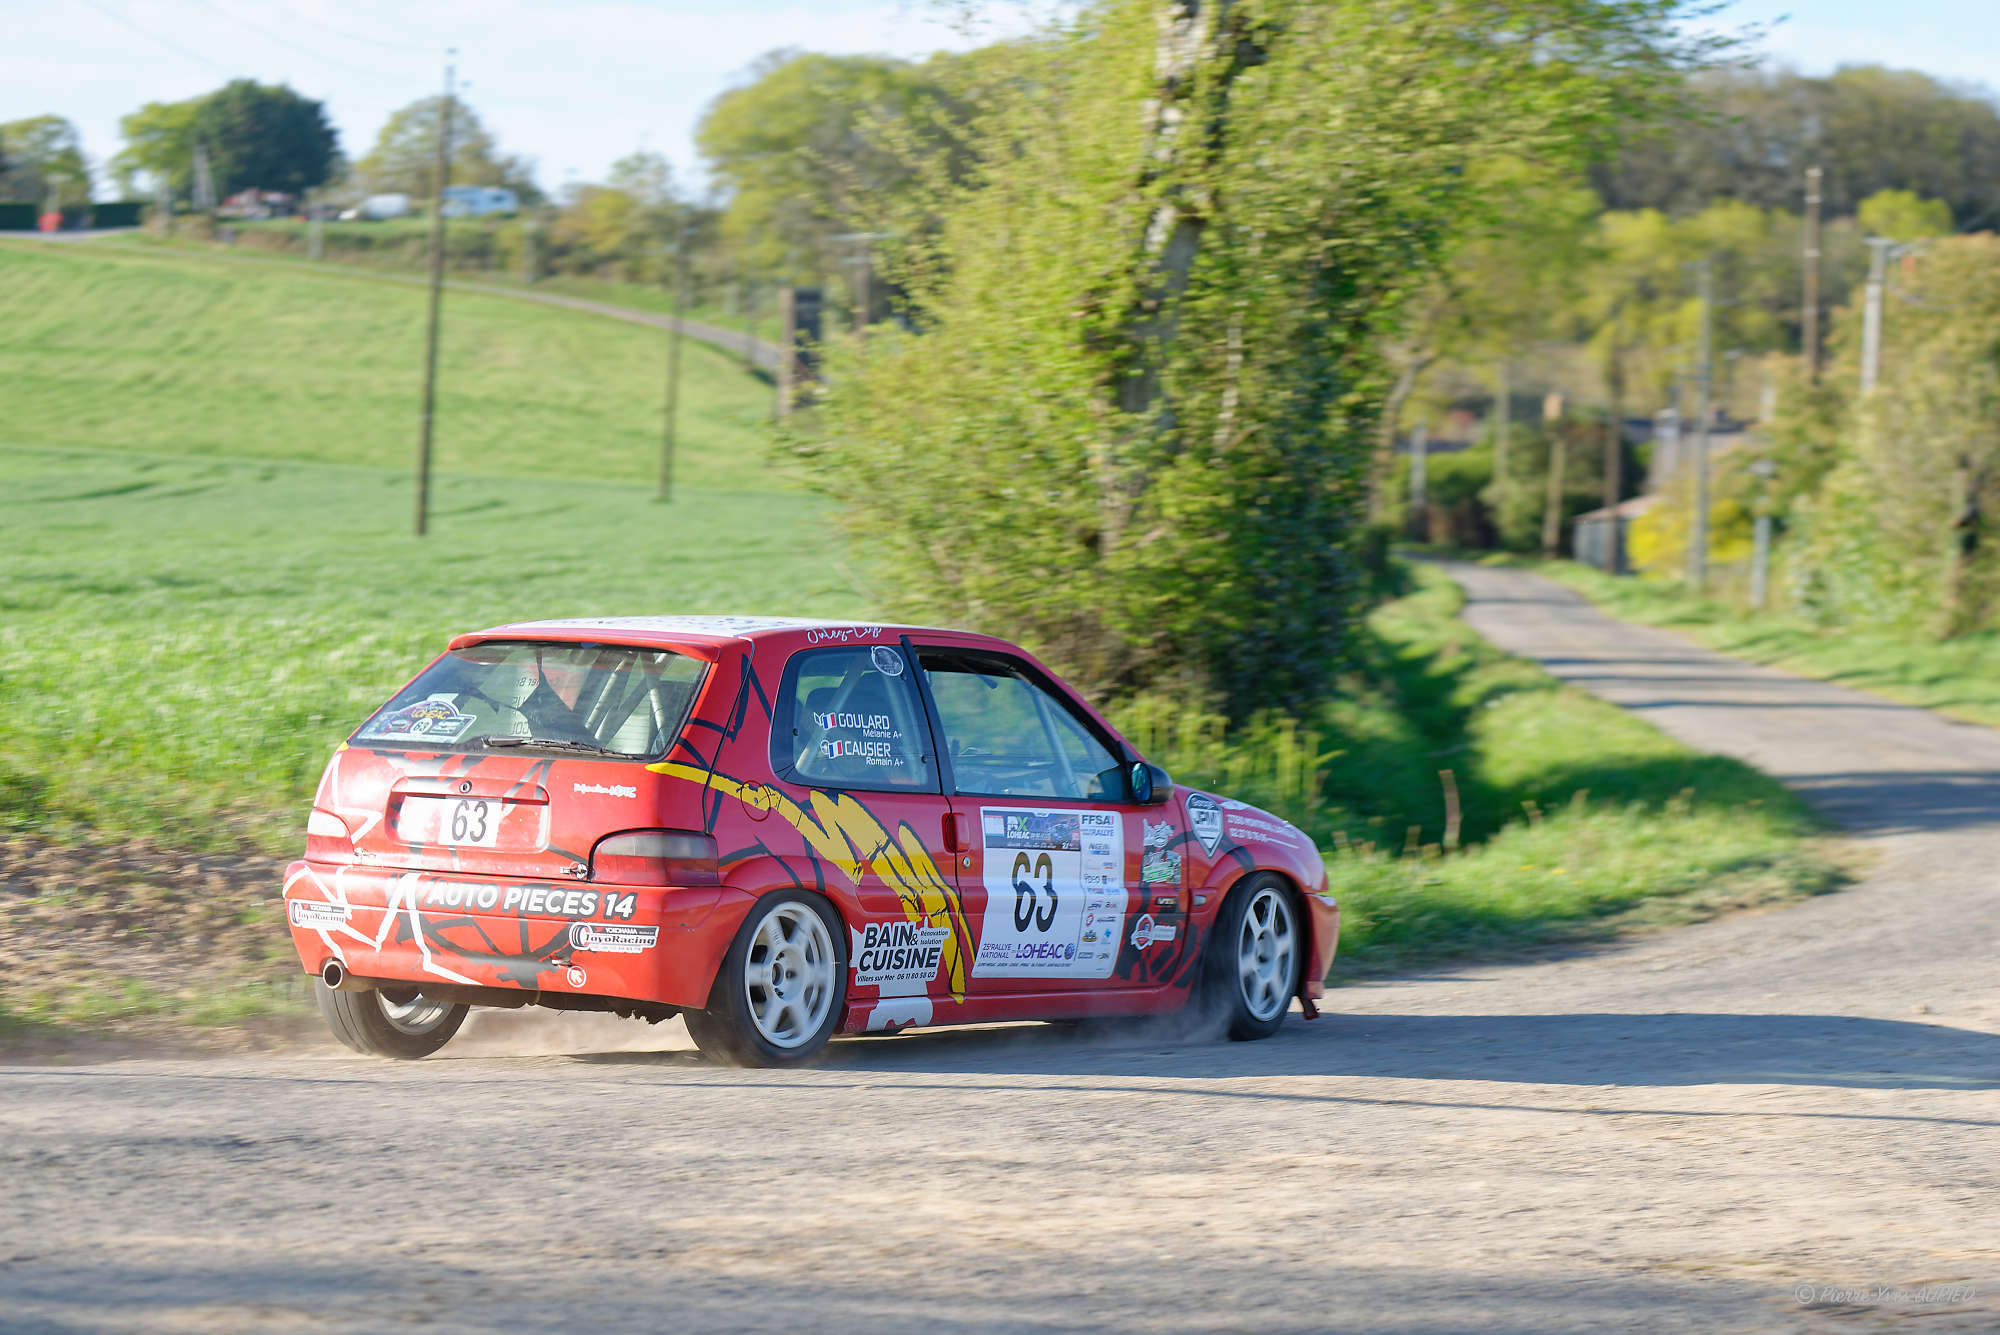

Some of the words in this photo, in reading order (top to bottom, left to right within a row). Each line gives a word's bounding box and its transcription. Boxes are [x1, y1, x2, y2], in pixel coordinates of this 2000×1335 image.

[838, 713, 890, 729] GOULARD
[862, 729, 891, 738] Mélanie
[893, 731, 902, 739] A+
[844, 741, 891, 757] CAUSIER
[866, 757, 893, 766] Romain
[894, 758, 904, 767] A+
[452, 799, 489, 842] 63
[1081, 815, 1111, 825] FFSA
[427, 881, 499, 908] AUTO
[503, 886, 598, 916] PIECES
[605, 893, 635, 918] 14
[1012, 851, 1058, 932] 63
[864, 925, 914, 948] BAIN
[910, 933, 919, 945] &
[920, 928, 949, 936] Rénovation
[980, 951, 1009, 959] NATIONAL
[1016, 941, 1064, 959] LOHÉAC
[859, 947, 941, 971] CUISINE
